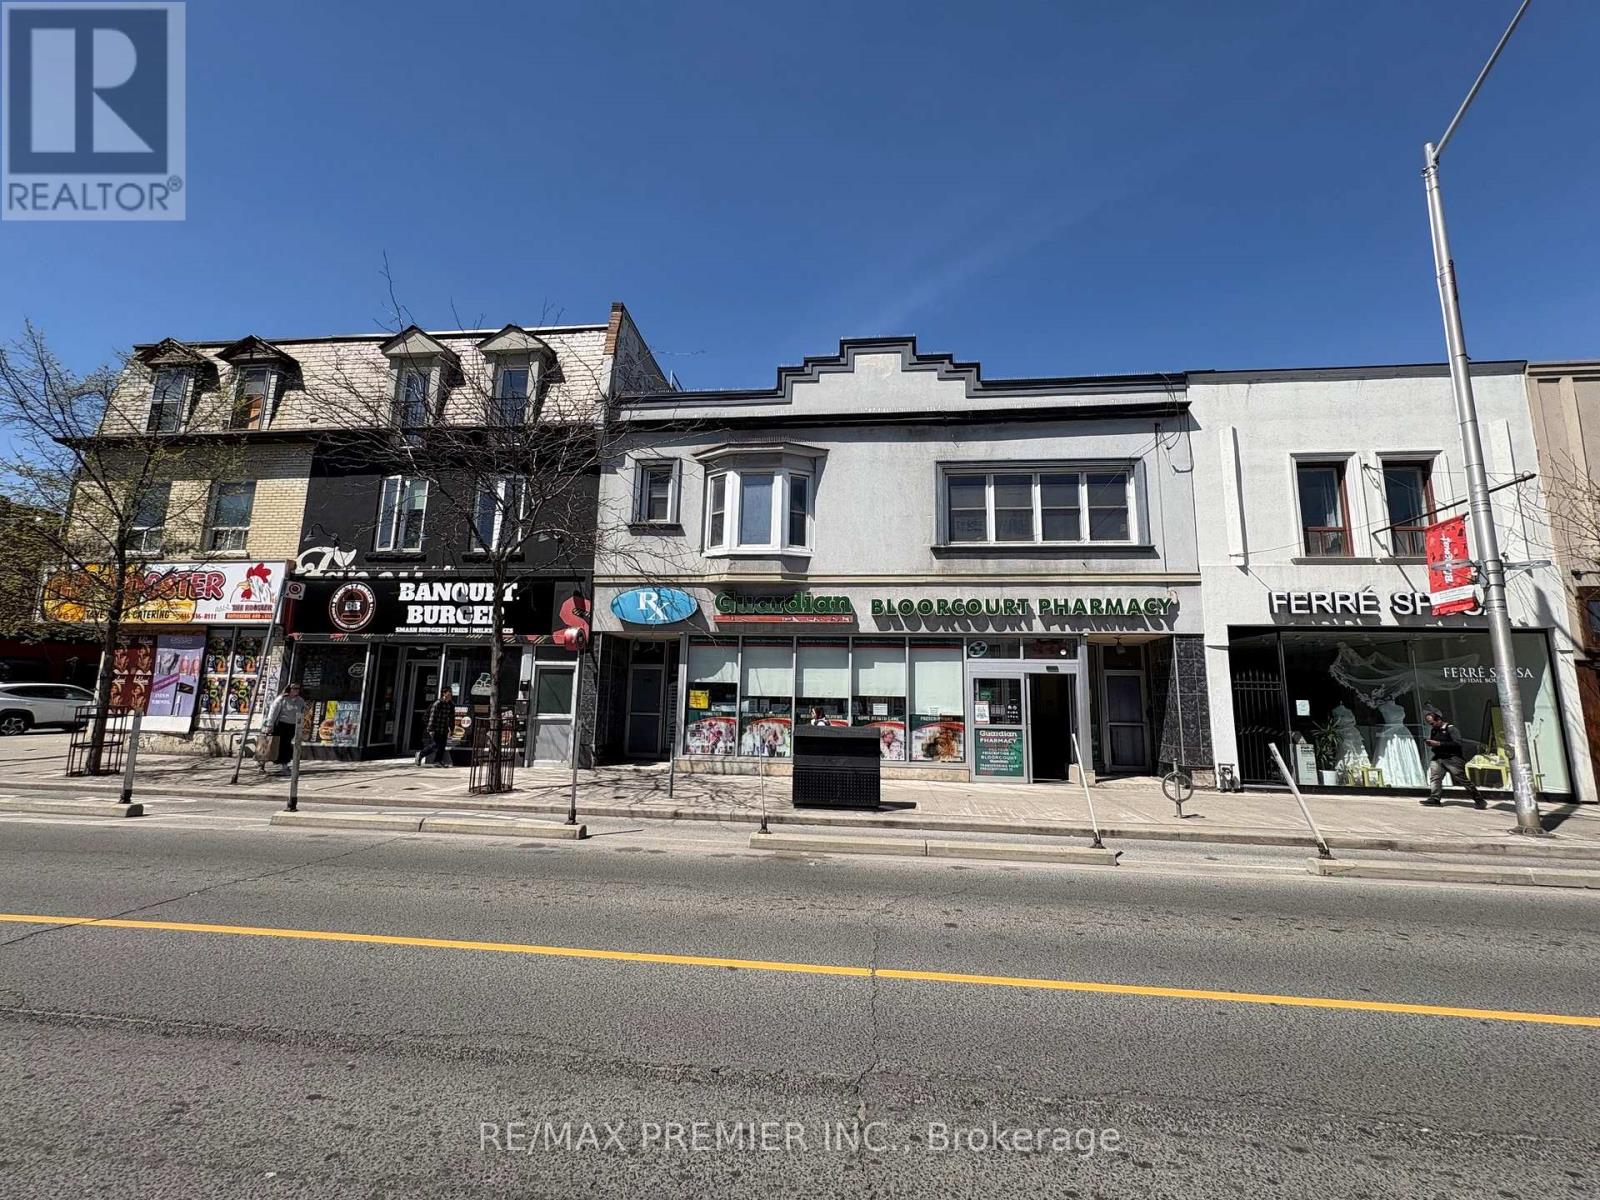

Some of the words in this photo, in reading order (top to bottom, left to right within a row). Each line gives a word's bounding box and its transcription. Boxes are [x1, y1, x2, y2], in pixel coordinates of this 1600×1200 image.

[714, 591, 853, 614] Guardian
[871, 597, 1029, 616] BLOORCOURT
[1038, 597, 1173, 616] PHARMACY
[1269, 585, 1381, 615] FERRÉ
[132, 609, 170, 619] CATERING
[1443, 665, 1485, 678] FERRÉ
[1489, 667, 1535, 678] SSA
